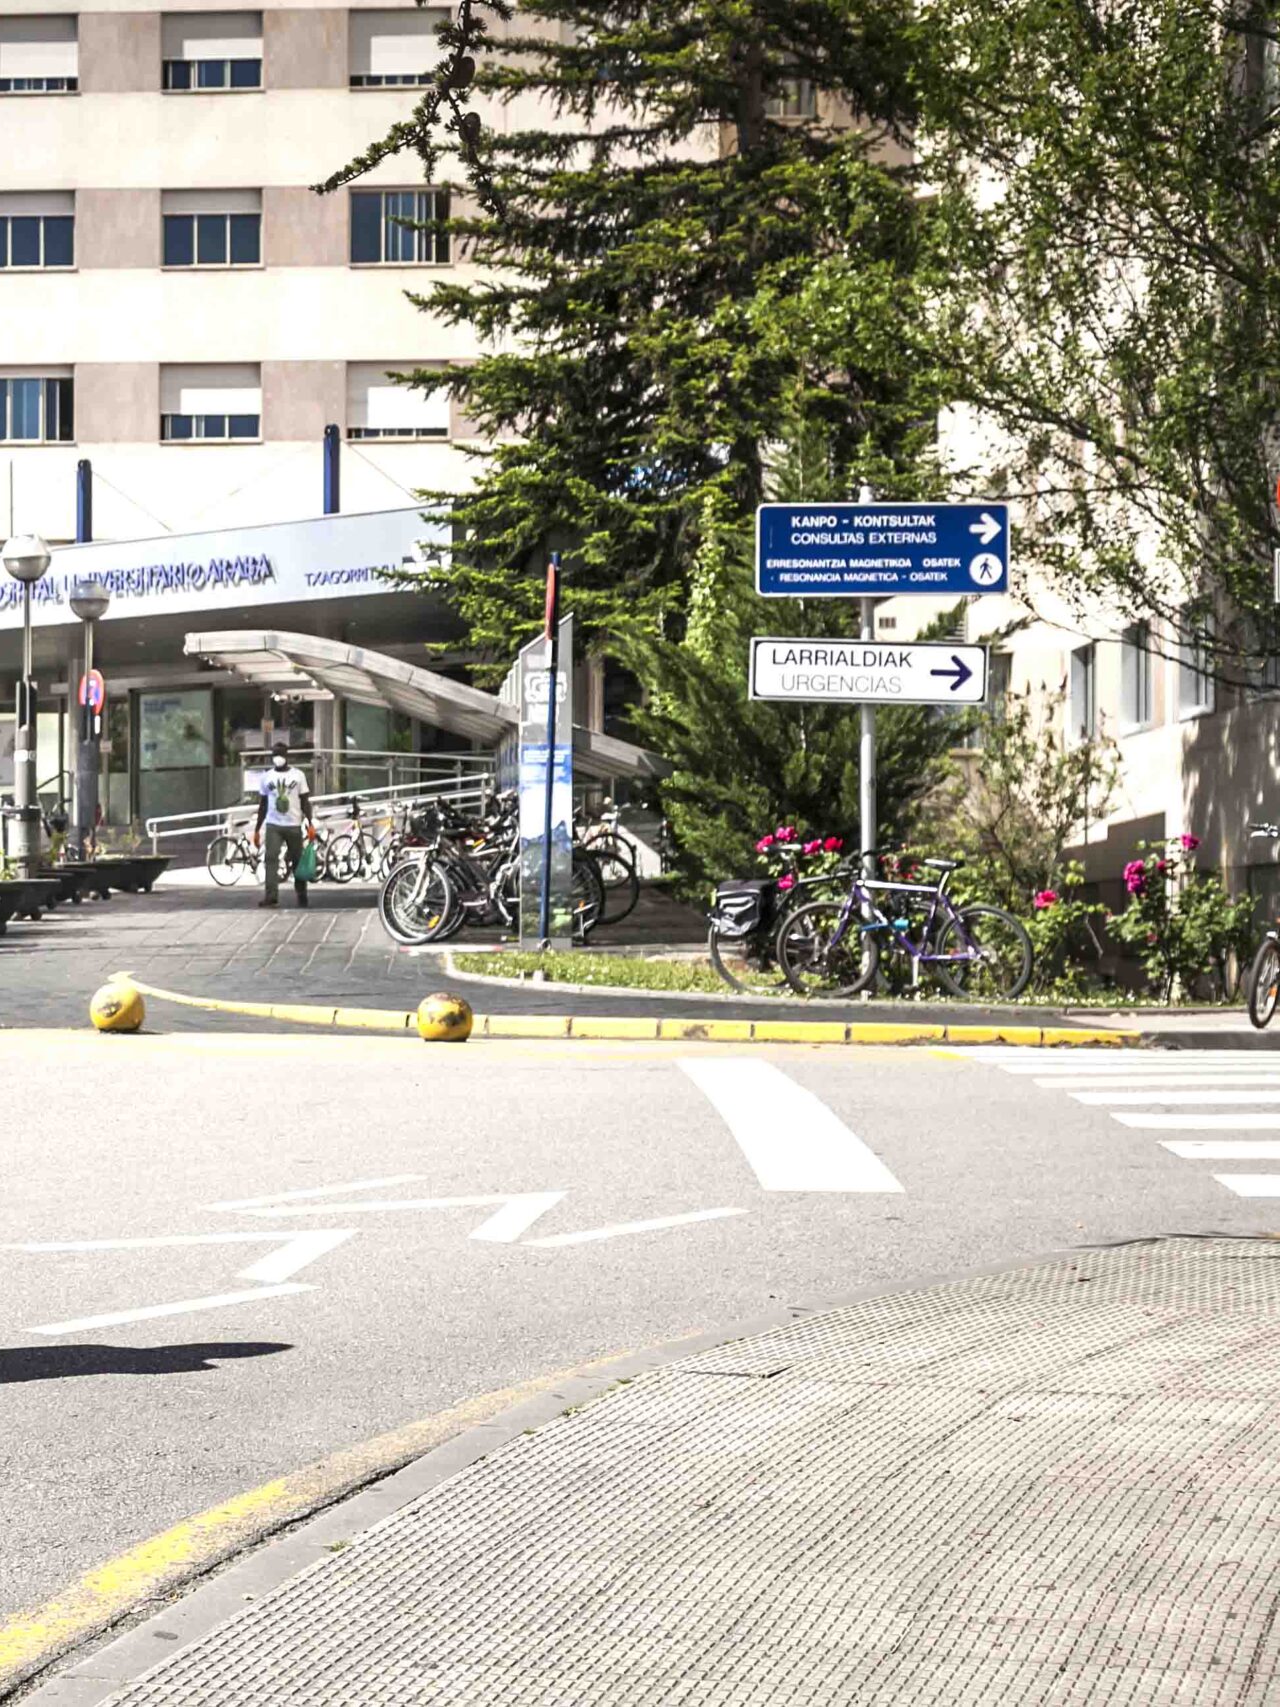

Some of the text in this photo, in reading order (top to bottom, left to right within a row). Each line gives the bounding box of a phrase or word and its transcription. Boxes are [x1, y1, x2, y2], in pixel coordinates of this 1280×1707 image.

[791, 516, 837, 528] KANPO
[853, 515, 935, 528] KONTSULTAK
[791, 532, 937, 545] CONSULTAS EXTERNAS
[766, 558, 961, 568] ERRESONANTZIA MAGNETIKOA OSATEK
[64, 563, 206, 596] UVERSITARIO
[206, 554, 274, 583] ARABA
[780, 573, 841, 583] RESONANCIA
[843, 572, 898, 582] MAGNETICA
[910, 572, 948, 582] OSATEK
[772, 648, 913, 668] LARRIALDIAK
[781, 674, 902, 694] URGENCIAS
